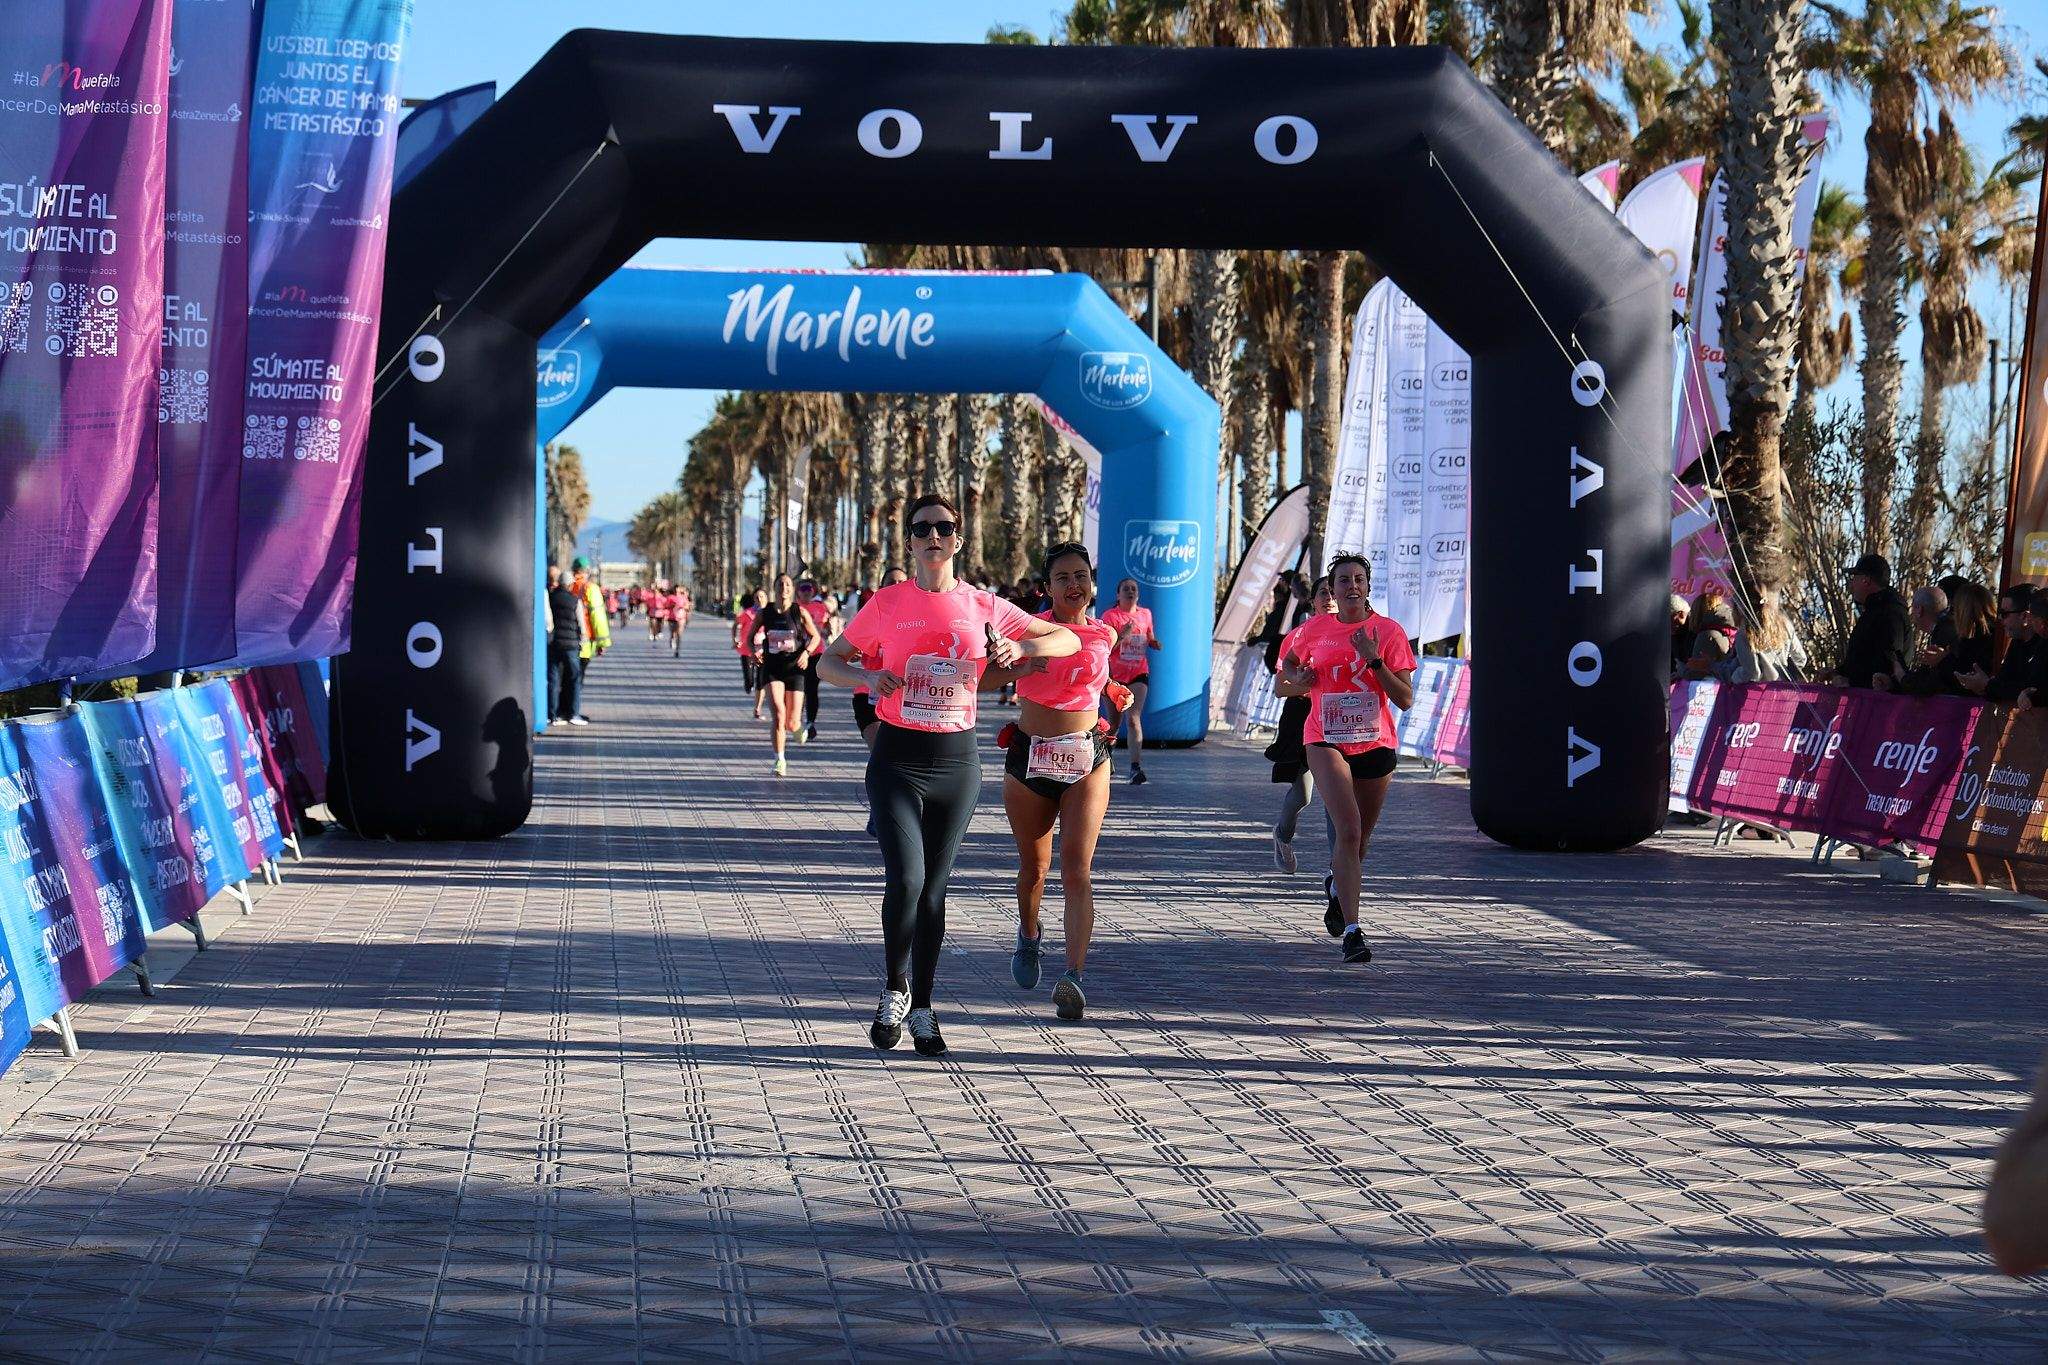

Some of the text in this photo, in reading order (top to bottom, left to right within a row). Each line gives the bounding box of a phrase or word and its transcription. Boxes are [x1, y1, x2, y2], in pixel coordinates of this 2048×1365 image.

[267, 36, 401, 62] VISIBILICEMOS
[279, 61, 374, 85] JUNTOS EL
[258, 82, 398, 114] CÁNCER DE MAMA
[171, 109, 229, 122] AstraZeneca
[264, 111, 384, 137] METASTÁSICO
[713, 104, 1319, 165] VOLVO
[88, 192, 117, 220] AL
[184, 302, 207, 321] AL
[251, 352, 344, 382] SÚMATE AL
[249, 382, 343, 402] MOVIMIENTO
[405, 334, 447, 772] VOLVO
[1567, 360, 1606, 788] VOLVO
[896, 619, 926, 630] OYSHO
[929, 686, 954, 698] 016
[1342, 714, 1363, 724] 016
[1783, 715, 1843, 773] renfe
[1051, 752, 1075, 763] 016
[1873, 727, 1938, 788] renfe
[1986, 763, 2032, 787] Institutos
[1865, 793, 1886, 812] TREN
[1980, 787, 2044, 818] Odontológicos
